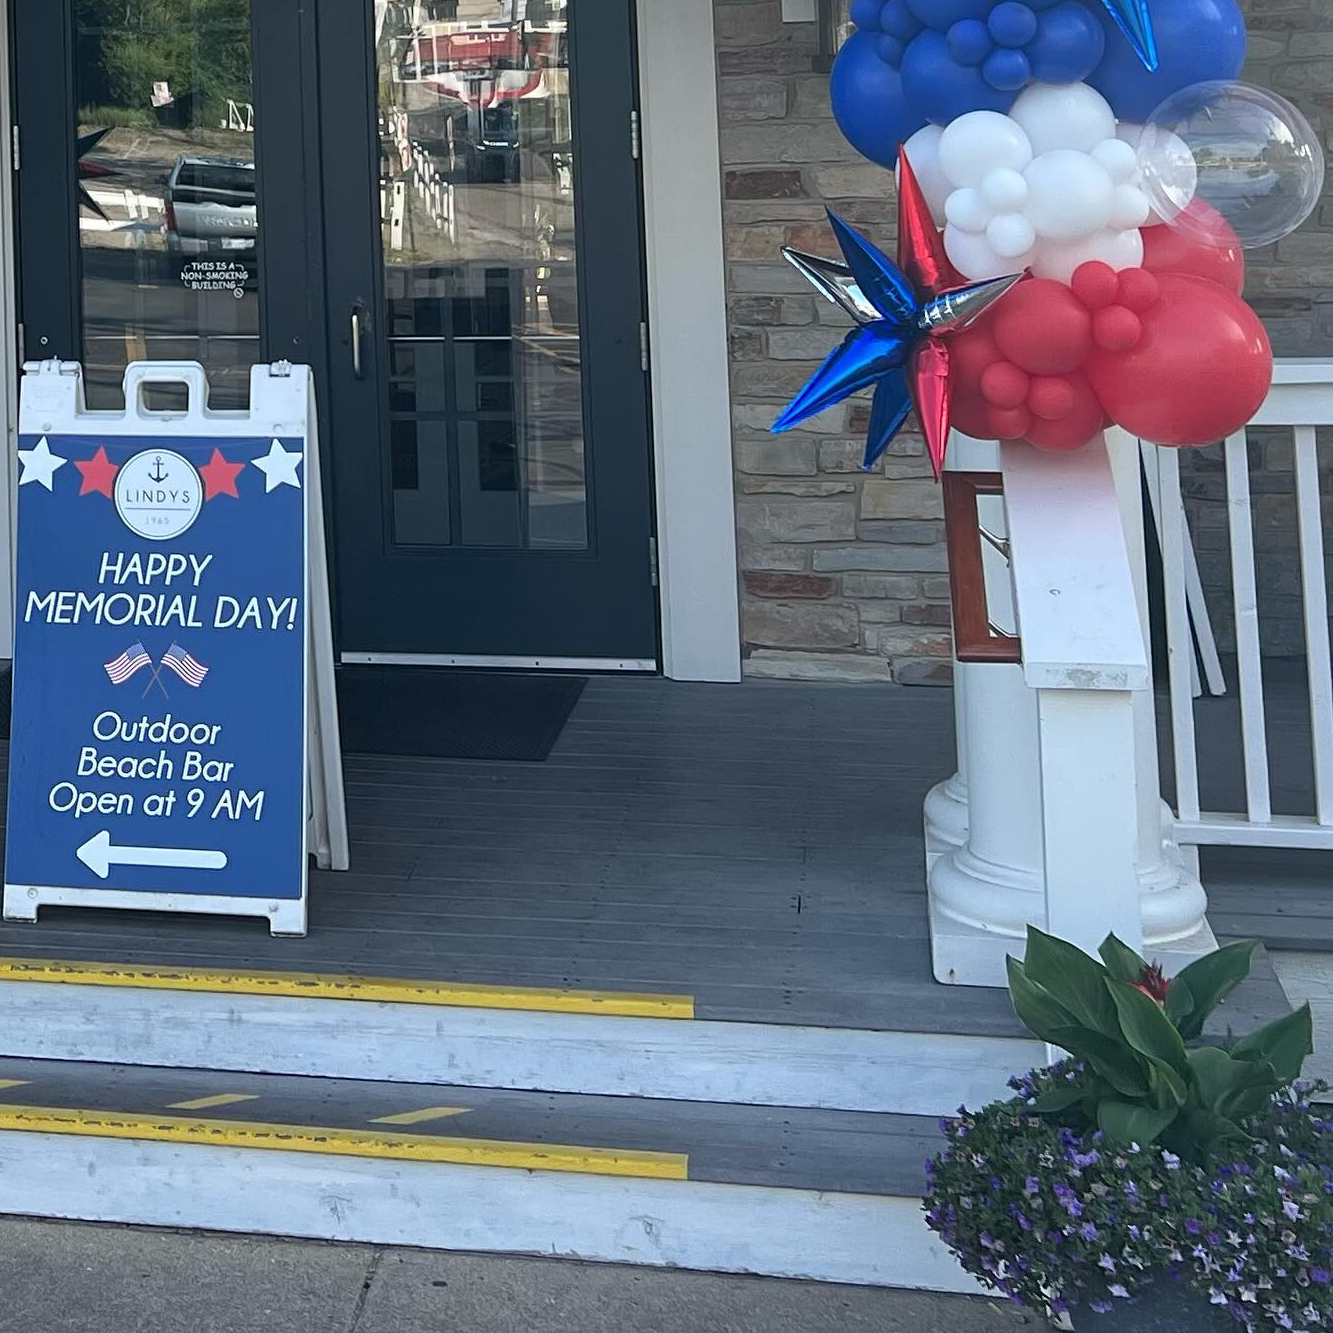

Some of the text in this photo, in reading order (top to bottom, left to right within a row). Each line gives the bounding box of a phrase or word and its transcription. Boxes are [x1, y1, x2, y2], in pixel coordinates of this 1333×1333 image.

[180, 271, 249, 280] NON-SMOKING
[191, 262, 235, 270] THIS IS A
[191, 281, 236, 290] BUILDING
[126, 489, 190, 503] LINDYS
[98, 552, 213, 586] HAPPY
[24, 591, 298, 630] MEMORIAL DAY!
[92, 711, 221, 745] Outdoor
[77, 747, 234, 783] Beach Bar
[48, 782, 265, 821] Open at 9 AM
